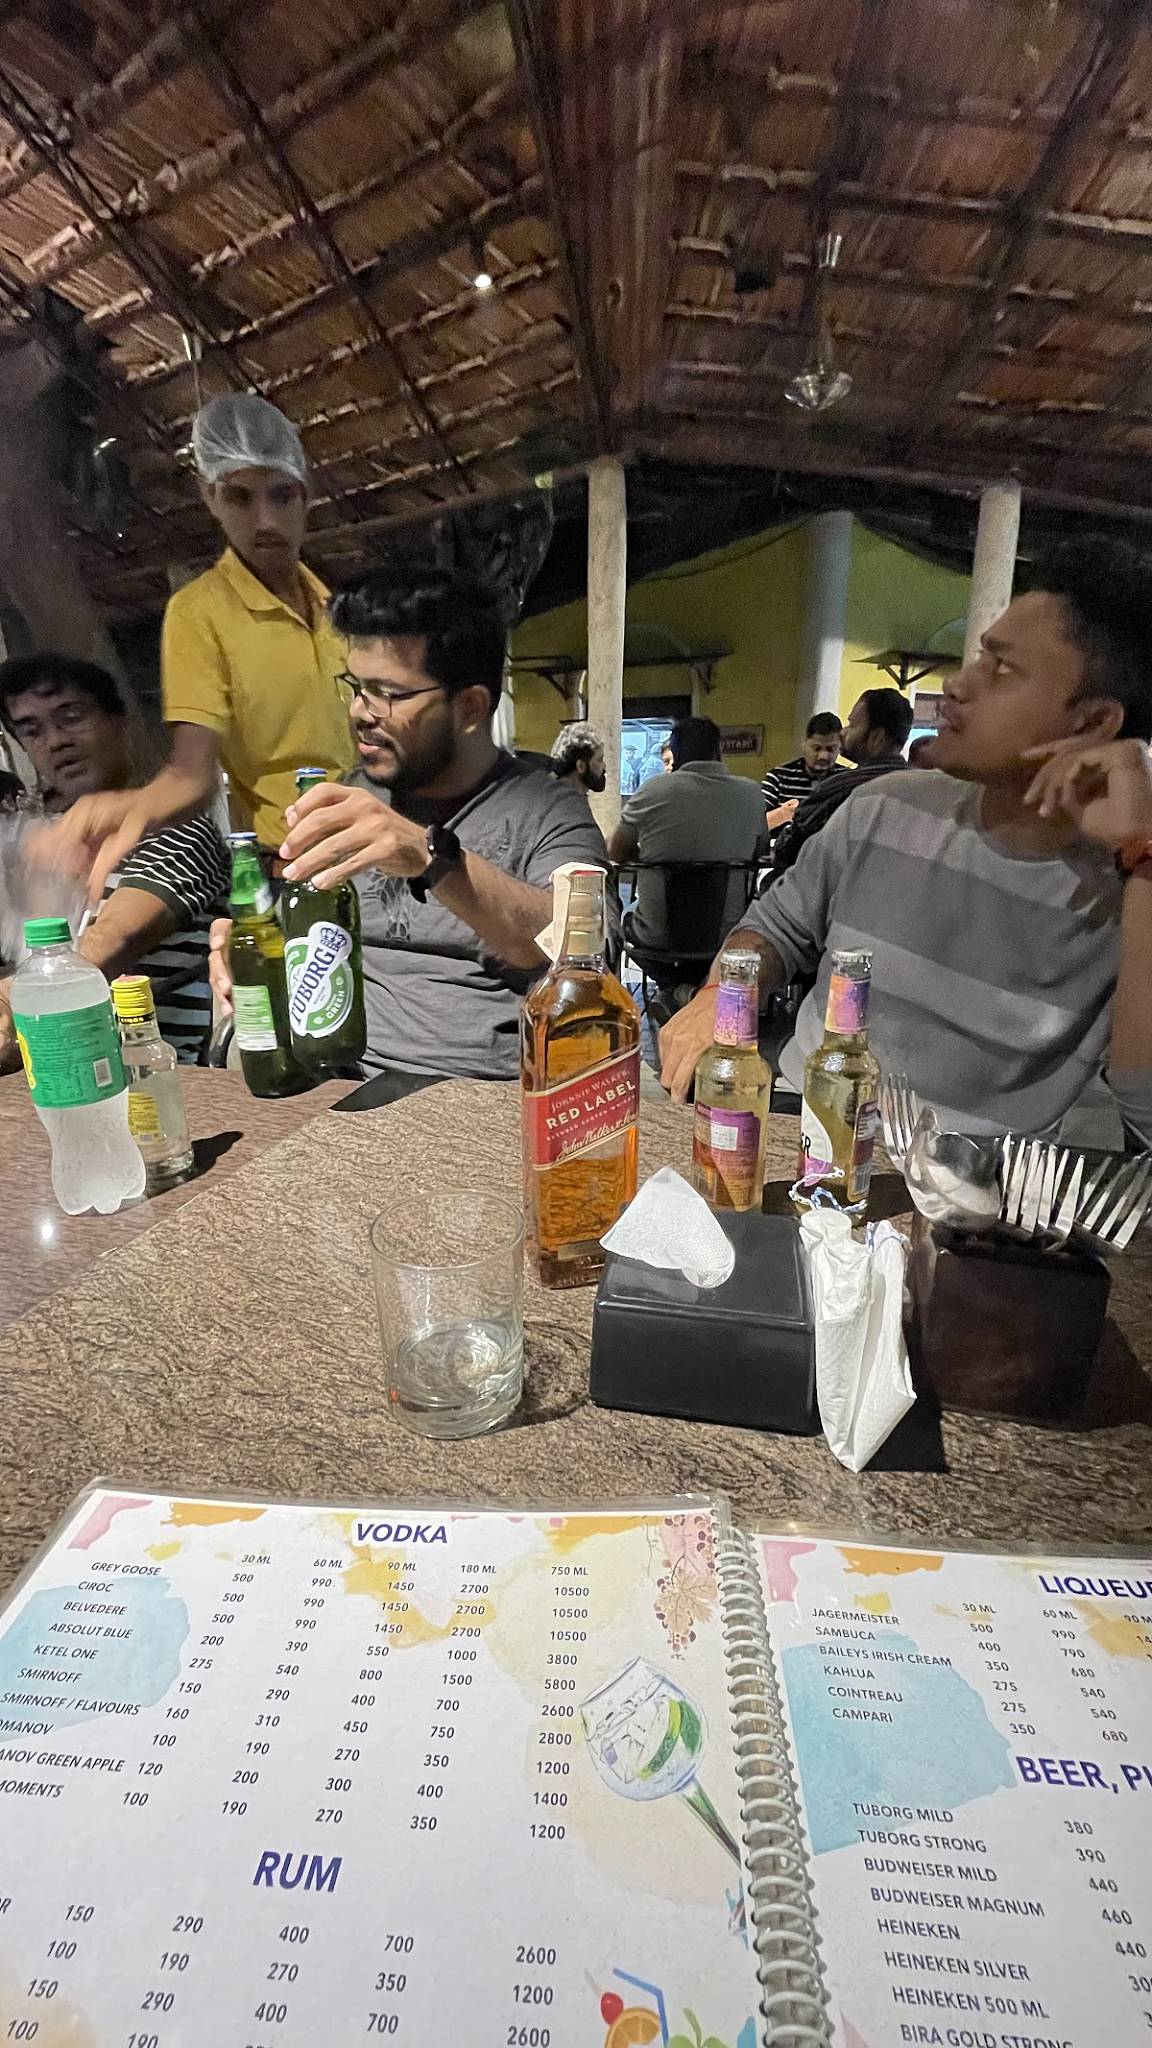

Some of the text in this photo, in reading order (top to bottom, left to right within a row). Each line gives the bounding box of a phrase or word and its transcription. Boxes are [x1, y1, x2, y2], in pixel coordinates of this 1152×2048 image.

[290, 947, 336, 1025] TUBORG
[326, 990, 345, 1019] GREEN
[545, 1107, 580, 1130] RED
[584, 1080, 636, 1112] LABEL
[358, 1523, 447, 1543] VODKA
[241, 1555, 270, 1564] 30 ML
[313, 1559, 343, 1568] 60 ML
[92, 1562, 161, 1575] GREY GOOSE
[388, 1562, 416, 1571] 90 ML
[461, 1565, 496, 1573] 180 ML
[552, 1567, 588, 1575] 750 ML
[232, 1573, 254, 1582] 500
[312, 1578, 332, 1587] 990
[78, 1581, 114, 1592] CIROC
[389, 1582, 414, 1591] 1450
[460, 1584, 488, 1593] 2700
[555, 1587, 589, 1596] 10500
[223, 1593, 244, 1603] 500
[304, 1598, 324, 1607] 990
[64, 1602, 127, 1615] BELVEDERE
[382, 1602, 408, 1611] 1450
[456, 1605, 485, 1615] 2700
[553, 1608, 588, 1618] 10500
[962, 1603, 996, 1616] 30 ML
[212, 1614, 234, 1623] 500
[812, 1608, 899, 1625] JAGERMEISTER
[1043, 1610, 1078, 1620] 60 ML
[48, 1623, 133, 1638] ABSOLUT BLUE
[296, 1619, 316, 1629] 990
[375, 1624, 402, 1633] 1450
[970, 1623, 993, 1633] 500
[452, 1627, 480, 1637] 2700
[551, 1631, 586, 1641] 10500
[816, 1627, 876, 1640] SAMBUCA
[1052, 1630, 1075, 1639] 990
[201, 1636, 224, 1646] 200
[286, 1641, 308, 1652] 390
[978, 1642, 1001, 1652] 400
[34, 1645, 98, 1659] KETEL ONE
[367, 1646, 389, 1656] 550
[448, 1650, 476, 1661] 1000
[819, 1645, 952, 1666] BAILEYS IRISH CREAM
[1061, 1648, 1085, 1658] 790
[189, 1658, 213, 1669] 275
[547, 1654, 577, 1665] 3800
[985, 1661, 1009, 1671] 350
[17, 1668, 82, 1683] SMIRNOFF
[276, 1665, 299, 1675] 540
[360, 1670, 382, 1680] 800
[824, 1666, 875, 1679] KAHLUA
[1072, 1668, 1095, 1678] 680
[443, 1674, 472, 1685] 1500
[545, 1679, 575, 1690] 5800
[993, 1681, 1017, 1691] 275
[179, 1682, 201, 1693] 150
[1080, 1688, 1105, 1698] 540
[266, 1689, 289, 1701] 290
[351, 1695, 375, 1706] 400
[828, 1687, 903, 1702] COINTREAU
[2, 1693, 141, 1715] SMIRNOFF / FLAVOURS
[437, 1699, 459, 1711] 700
[1001, 1702, 1026, 1713] 275
[167, 1708, 189, 1719] 160
[542, 1705, 573, 1717] 2600
[833, 1708, 892, 1723] CAMPARI
[1090, 1709, 1116, 1720] 540
[0, 1719, 54, 1735] MANOV
[255, 1715, 280, 1727] 310
[344, 1721, 368, 1733] 450
[431, 1726, 454, 1738] 750
[1010, 1723, 1035, 1735] 350
[153, 1734, 176, 1746] 100
[539, 1733, 571, 1745] 2800
[1103, 1731, 1127, 1742] 680
[247, 1742, 270, 1755] 190
[335, 1749, 360, 1761] 270
[37, 1752, 82, 1767] GREEN
[81, 1758, 125, 1772] APPLE
[424, 1754, 449, 1767] 350
[139, 1762, 163, 1775] 120
[537, 1761, 569, 1774] 1200
[232, 1771, 258, 1784] 200
[1016, 1757, 1118, 1794] BEER,
[326, 1778, 351, 1791] 300
[417, 1785, 443, 1798] 400
[124, 1792, 148, 1806] 100
[534, 1792, 567, 1806] 1400
[223, 1801, 247, 1815] 190
[852, 1803, 953, 1822] TUBORG MILD
[316, 1809, 343, 1823] 270
[410, 1816, 437, 1830] 350
[1064, 1821, 1093, 1835] 380
[530, 1825, 565, 1839] 1200
[857, 1830, 986, 1853] TUBORG STRONG
[1076, 1848, 1105, 1863] 390
[253, 1851, 342, 1892] RUM
[864, 1858, 997, 1881] BUDWEISER MILD
[1089, 1878, 1118, 1893] 440
[871, 1887, 1044, 1916] BUDWEISER MAGNUM
[66, 1905, 94, 1922] 150
[1102, 1909, 1132, 1925] 460
[172, 1916, 203, 1933] 290
[877, 1919, 960, 1940] HEINEKEN
[279, 1926, 309, 1944] 400
[47, 1940, 77, 1959] 100
[385, 1935, 413, 1953] 700
[1116, 1942, 1147, 1958] 440
[161, 1952, 189, 1971] 190
[516, 1946, 556, 1965] 2600
[267, 1963, 298, 1982] 270
[884, 1952, 1030, 1981] HEINEKEN SILVER
[375, 1972, 406, 1992] 350
[28, 1979, 58, 1999] 150
[514, 1985, 553, 2005] 1200
[141, 1992, 174, 2012] 290
[892, 1986, 1049, 2018] HEINEKEN 500 ML
[255, 2003, 287, 2023] 400
[8, 2020, 39, 2040] 100
[367, 2013, 398, 2034] 700
[507, 2026, 550, 2048] 2600
[900, 2024, 944, 2045] BIRA
[947, 2029, 997, 2048] GOLD
